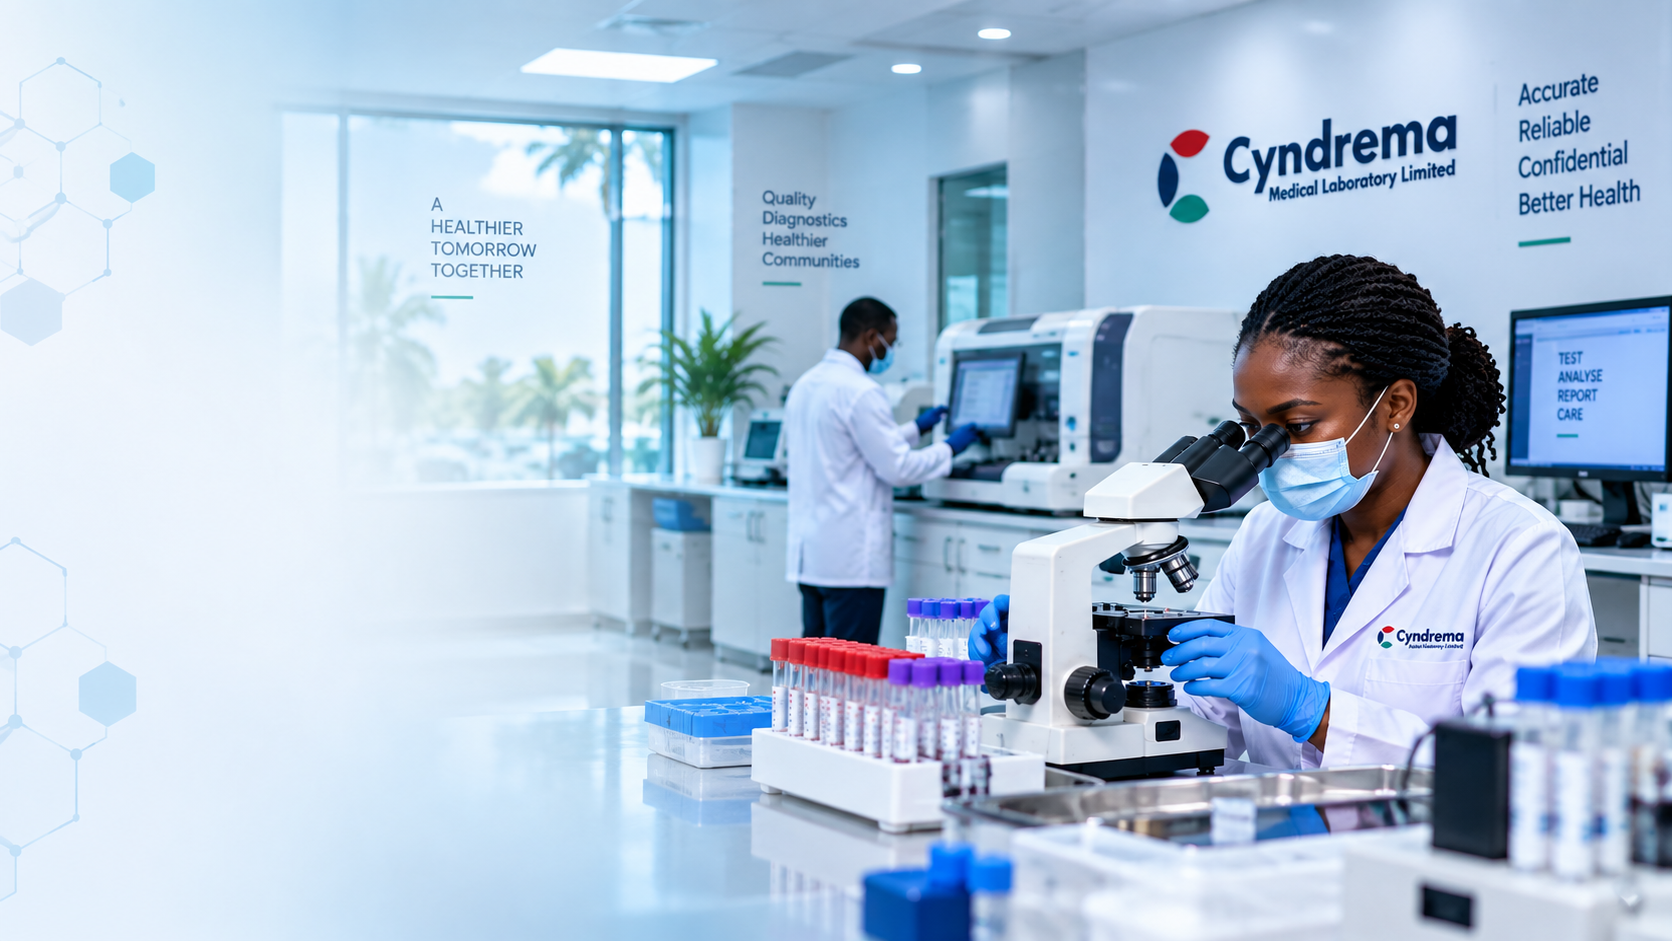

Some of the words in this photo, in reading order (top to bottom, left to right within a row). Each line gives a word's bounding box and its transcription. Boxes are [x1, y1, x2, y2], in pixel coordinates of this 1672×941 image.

[1518, 73, 1599, 107] Accurate
[1518, 111, 1591, 142] Reliable
[1223, 114, 1457, 194] Cyndrema
[1518, 140, 1629, 179] Confidential
[1268, 180, 1318, 202] Medical
[1322, 169, 1397, 194] Laboratory
[1401, 158, 1456, 182] Limited
[431, 197, 443, 212] A
[762, 190, 816, 210] Quality
[1518, 188, 1573, 215] Better
[1579, 179, 1641, 208] Health
[431, 219, 524, 236] HEALTHIER
[762, 210, 848, 229] Diagnostics
[762, 231, 828, 248] Healthier
[431, 241, 537, 257] TOMORROW
[762, 251, 860, 269] Communities
[431, 262, 524, 279] TOGETHER
[1558, 351, 1583, 365] TEST
[1558, 369, 1603, 383] ANALYSE
[1557, 389, 1598, 403] REPORT
[1557, 408, 1583, 421] CARE
[1396, 628, 1464, 646] Cyndrema
